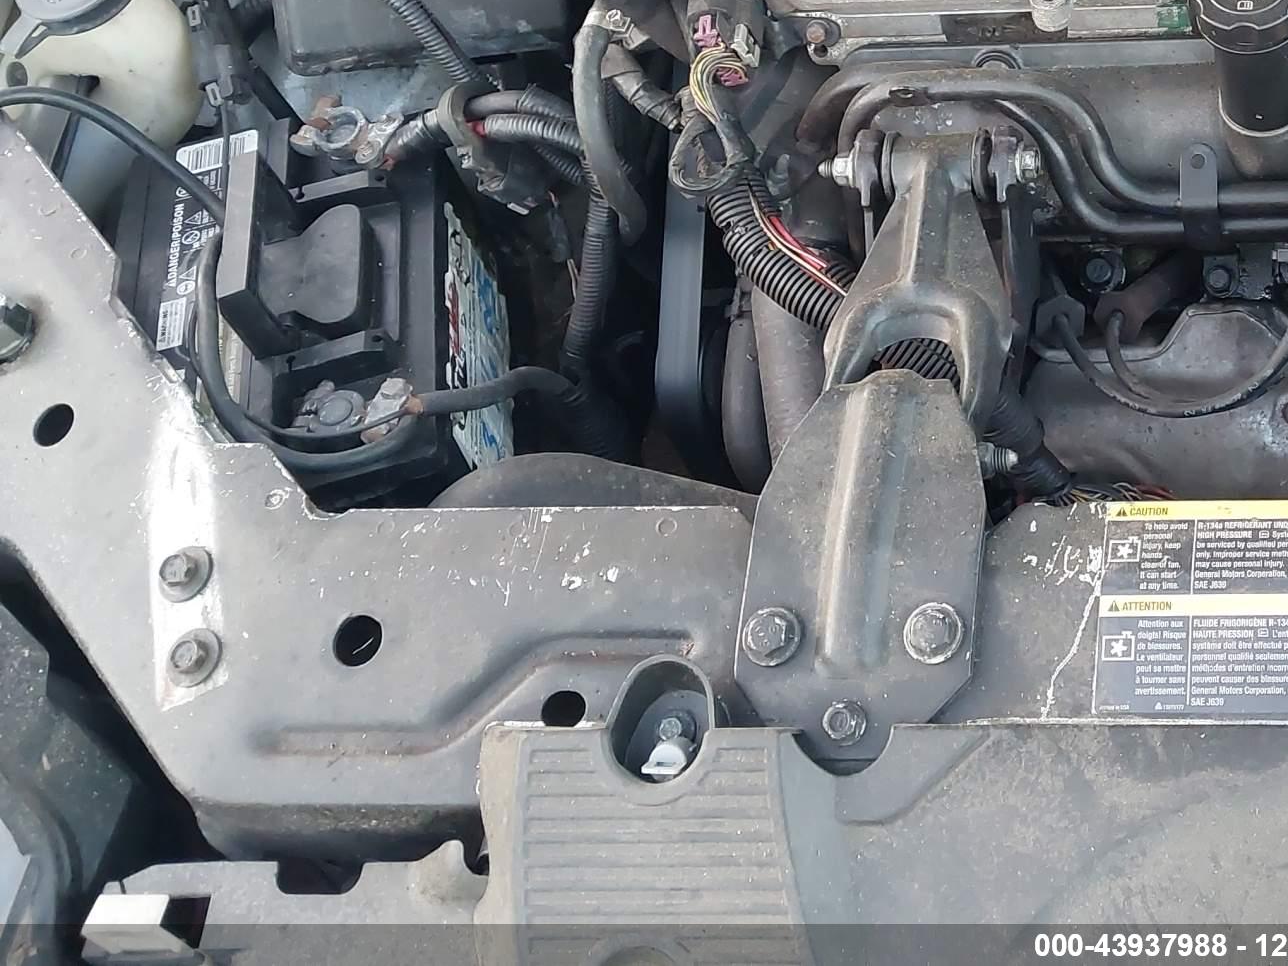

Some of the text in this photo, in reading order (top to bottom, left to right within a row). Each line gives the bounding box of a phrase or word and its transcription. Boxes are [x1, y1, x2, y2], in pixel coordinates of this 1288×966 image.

[167, 203, 184, 280] DANGER/POISON
[1129, 507, 1169, 516] CAUTION
[1154, 522, 1168, 531] help
[1170, 522, 1188, 530] avoid
[1198, 521, 1222, 530] R-134a
[1224, 521, 1272, 530] REFRIGERANT
[1143, 533, 1173, 541] personal
[1197, 531, 1214, 539] HIGH
[1215, 531, 1252, 539] PRESSURE
[1142, 542, 1181, 550] injury, keep
[1206, 540, 1235, 549] serviced
[1246, 540, 1276, 549] qualified
[1196, 550, 1211, 559] only.
[1213, 550, 1244, 559] Improper
[1245, 550, 1270, 558] service
[1195, 560, 1285, 569] may cause personal injury.
[1146, 571, 1159, 579] can
[1160, 571, 1177, 579] start
[1194, 570, 1220, 578] General
[1221, 570, 1245, 578] Motors
[1246, 570, 1287, 579] Corporation,
[1162, 581, 1179, 590] time.
[1122, 602, 1173, 611] ATTENTION
[1137, 620, 1184, 628] Attention aux
[1193, 618, 1218, 627] FLUIDE
[1220, 617, 1267, 627] FRIGORIGÈNE
[1193, 629, 1217, 638] HAUTE
[1218, 629, 1254, 638] PRESSION
[1191, 686, 1217, 695] General
[1219, 686, 1243, 695] Motors
[1244, 686, 1286, 696] Corporation,
[1190, 697, 1225, 706] SAE J639
